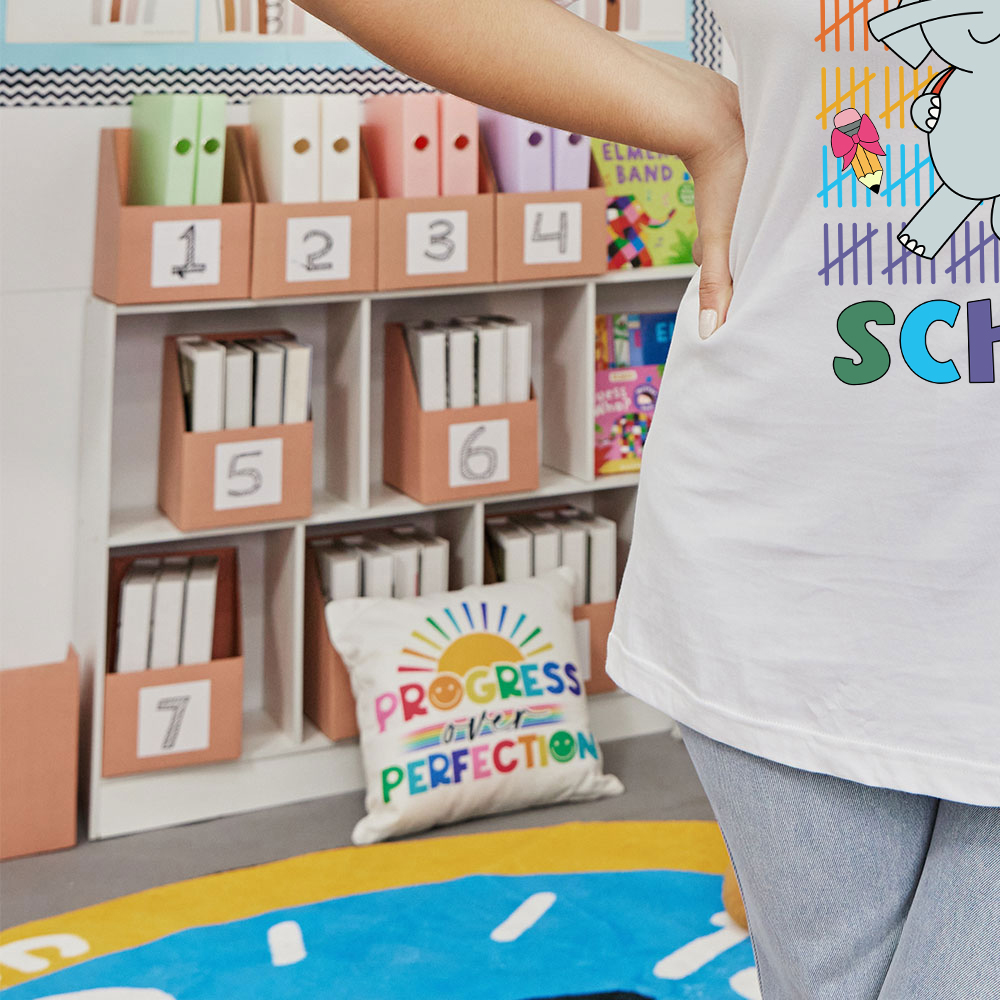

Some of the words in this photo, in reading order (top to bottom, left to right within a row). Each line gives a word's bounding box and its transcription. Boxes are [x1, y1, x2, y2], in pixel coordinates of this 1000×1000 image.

[615, 163, 673, 185] BAND
[171, 224, 207, 278] 1
[301, 229, 334, 272] 2
[424, 218, 456, 262] 3
[531, 210, 568, 254] 4
[226, 449, 264, 499] 5
[459, 425, 500, 482] 6
[157, 695, 192, 750] 7
[443, 709, 528, 743] over
